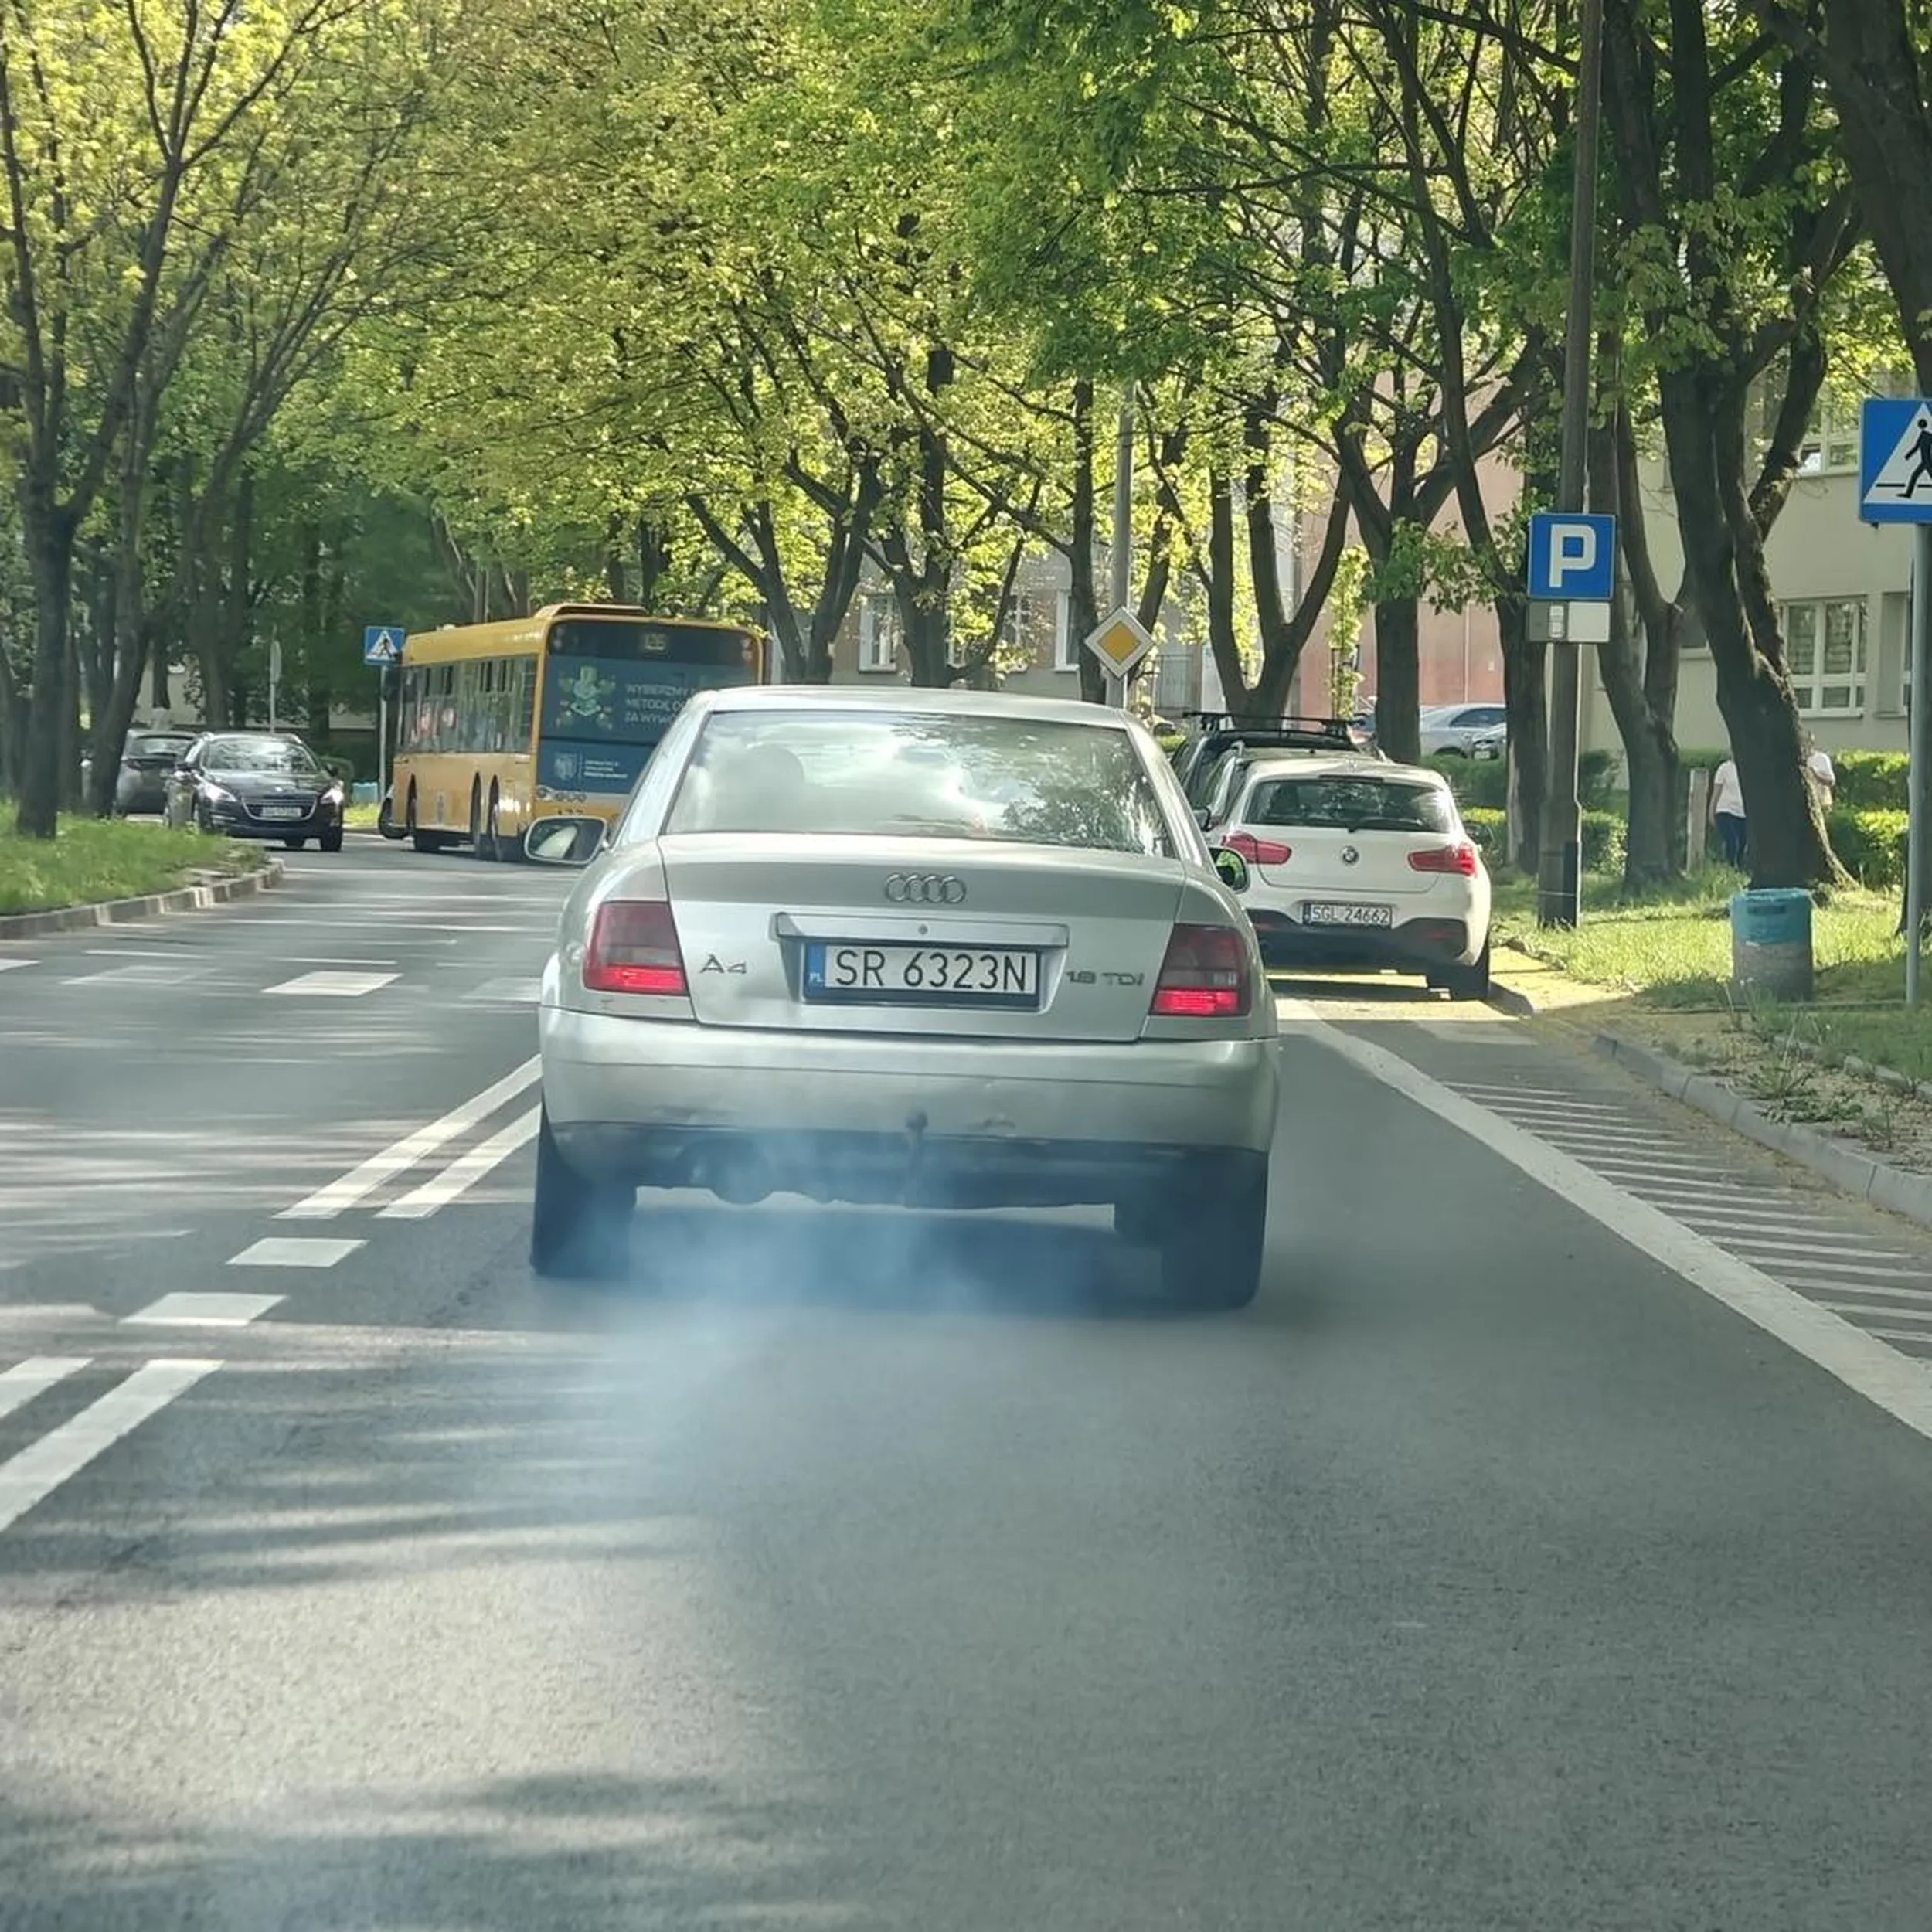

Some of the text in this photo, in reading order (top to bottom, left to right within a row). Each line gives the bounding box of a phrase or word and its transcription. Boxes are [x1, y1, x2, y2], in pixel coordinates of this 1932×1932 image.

[1549, 524, 1597, 588] P
[1313, 906, 1389, 924] SGL 24662
[698, 954, 747, 974] A4
[835, 949, 1026, 991] SR 6323N
[1101, 972, 1144, 986] TDI
